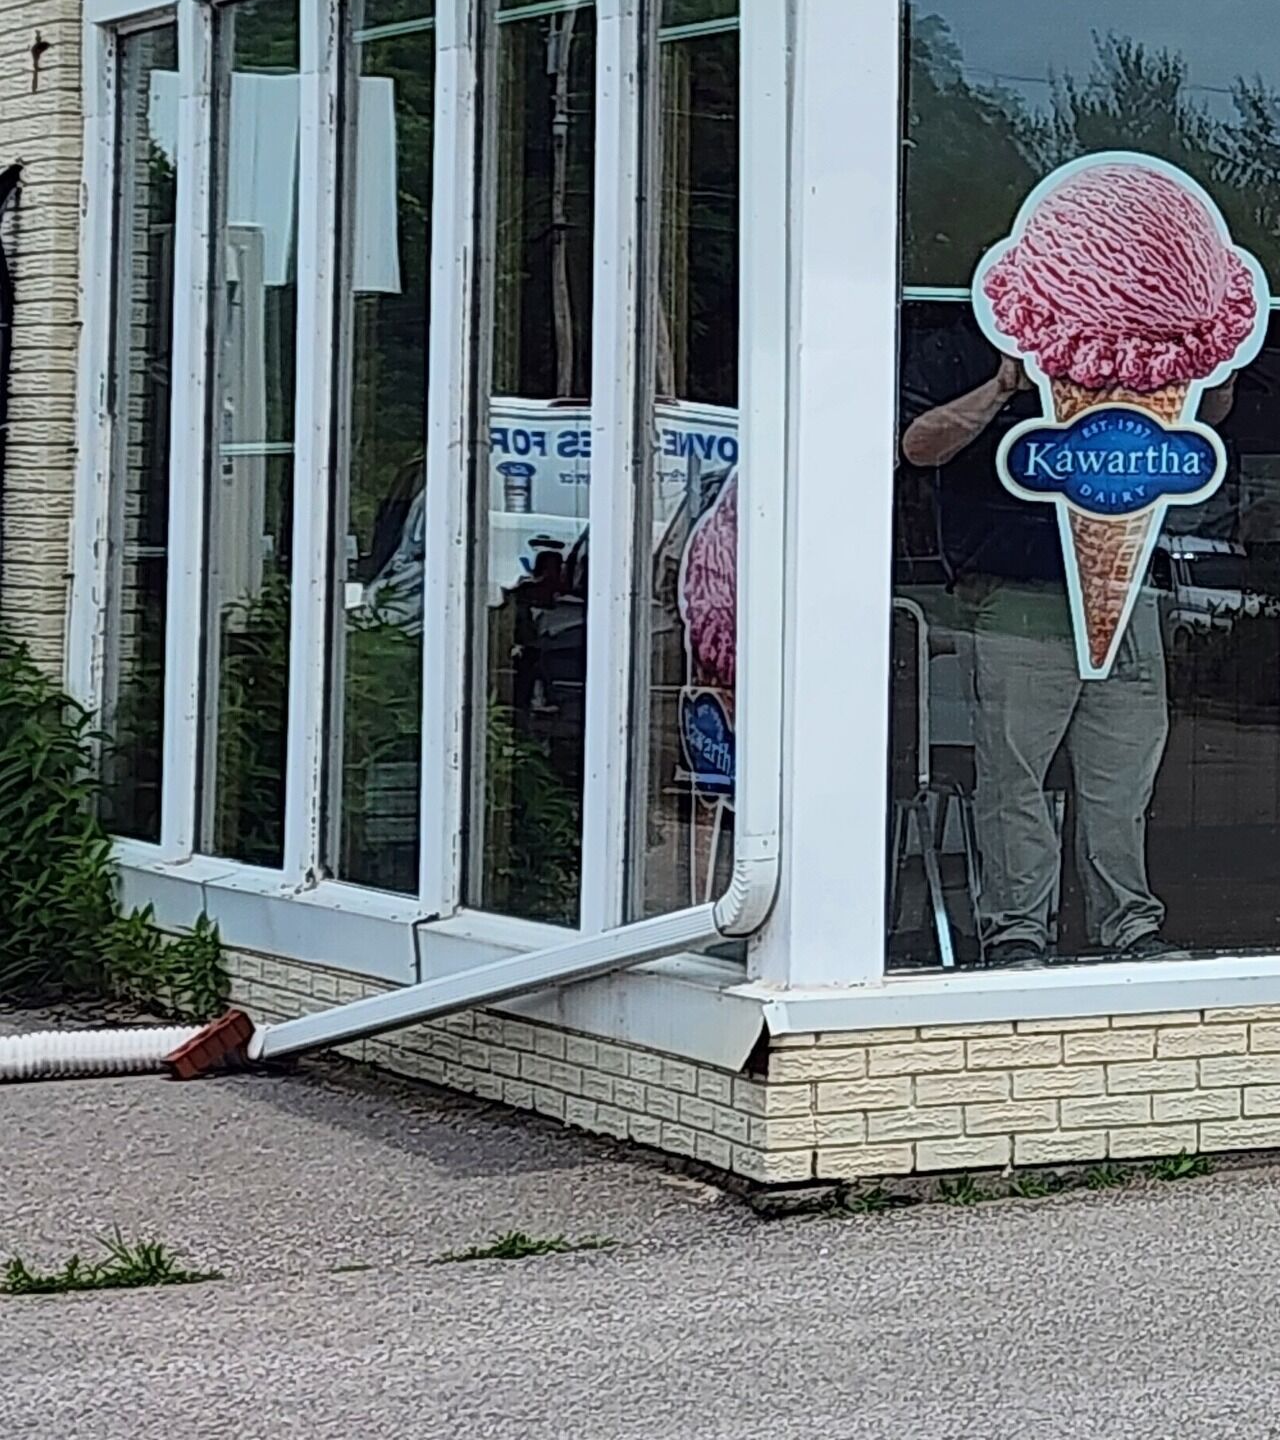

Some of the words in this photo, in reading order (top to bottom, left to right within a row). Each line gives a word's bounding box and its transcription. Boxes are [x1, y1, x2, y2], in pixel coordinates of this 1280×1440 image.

[1117, 419, 1153, 439] 1937
[1023, 442, 1202, 480] Kawartha
[1080, 484, 1147, 505] DAIRY
